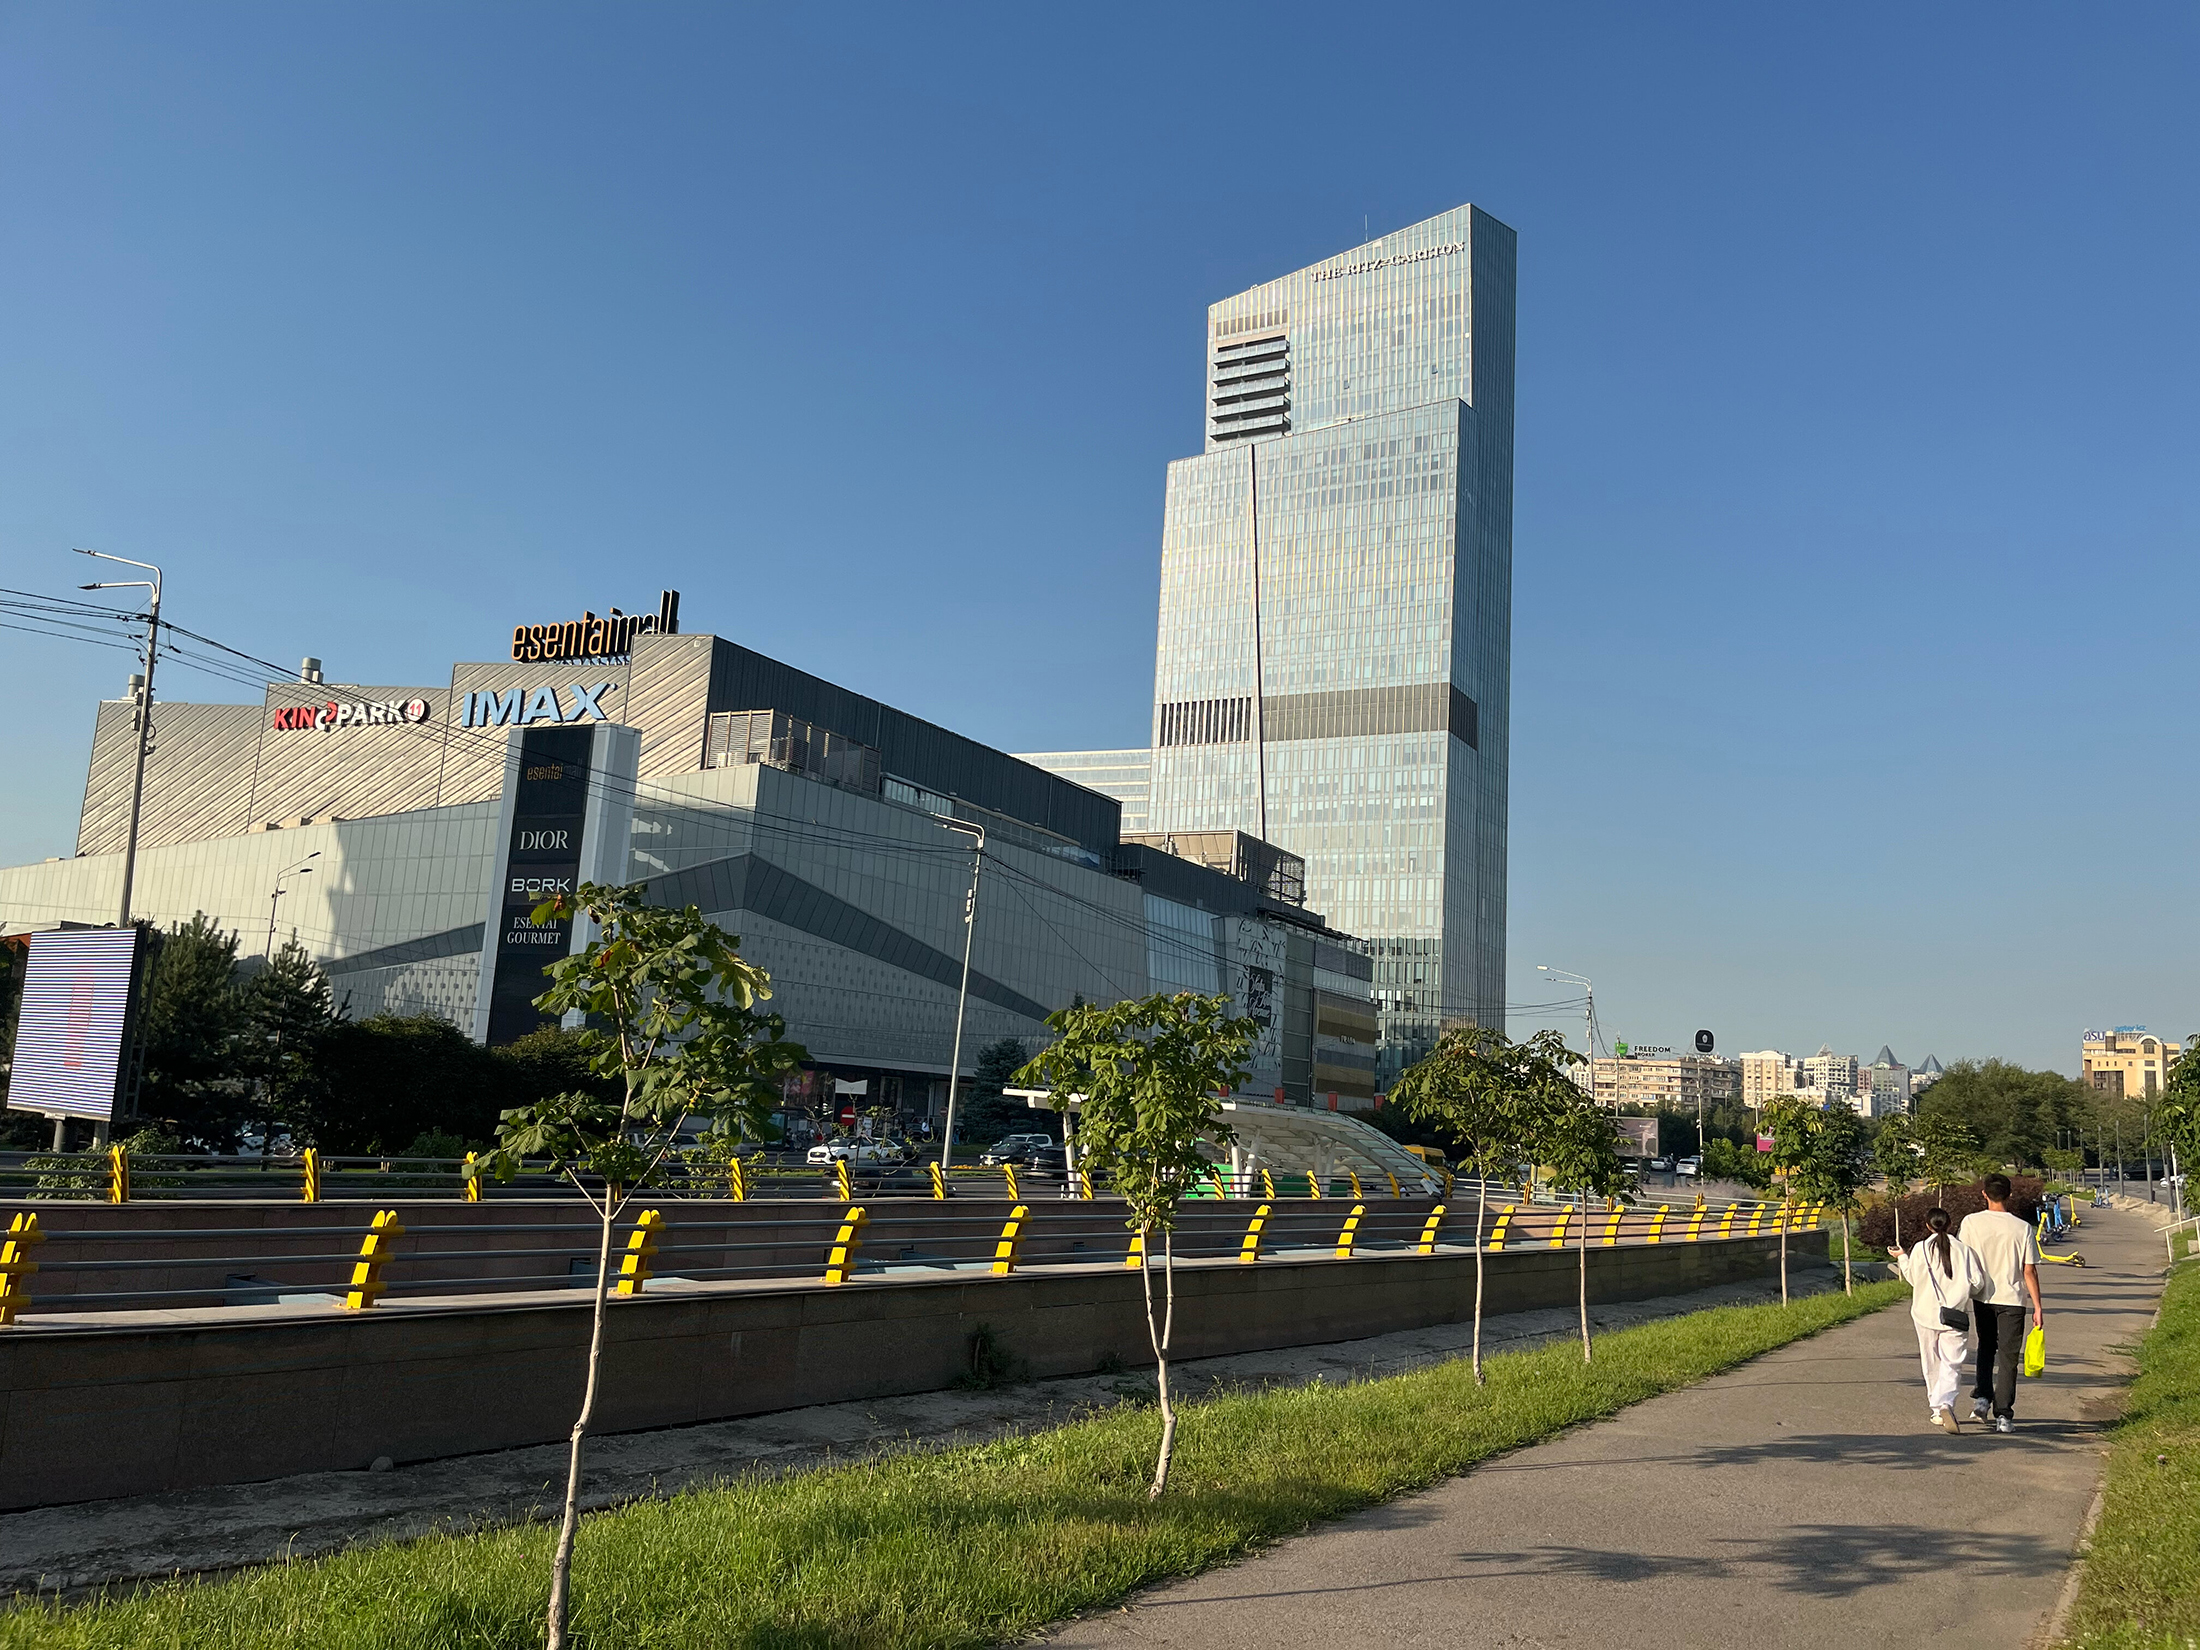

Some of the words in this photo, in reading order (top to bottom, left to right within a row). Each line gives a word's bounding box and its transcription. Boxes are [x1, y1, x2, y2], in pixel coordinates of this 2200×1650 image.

[1311, 267, 1343, 282] THE
[461, 683, 612, 727] IMAX
[520, 829, 568, 850] DIOR
[511, 878, 571, 892] BORK
[507, 931, 561, 945] GOURMET
